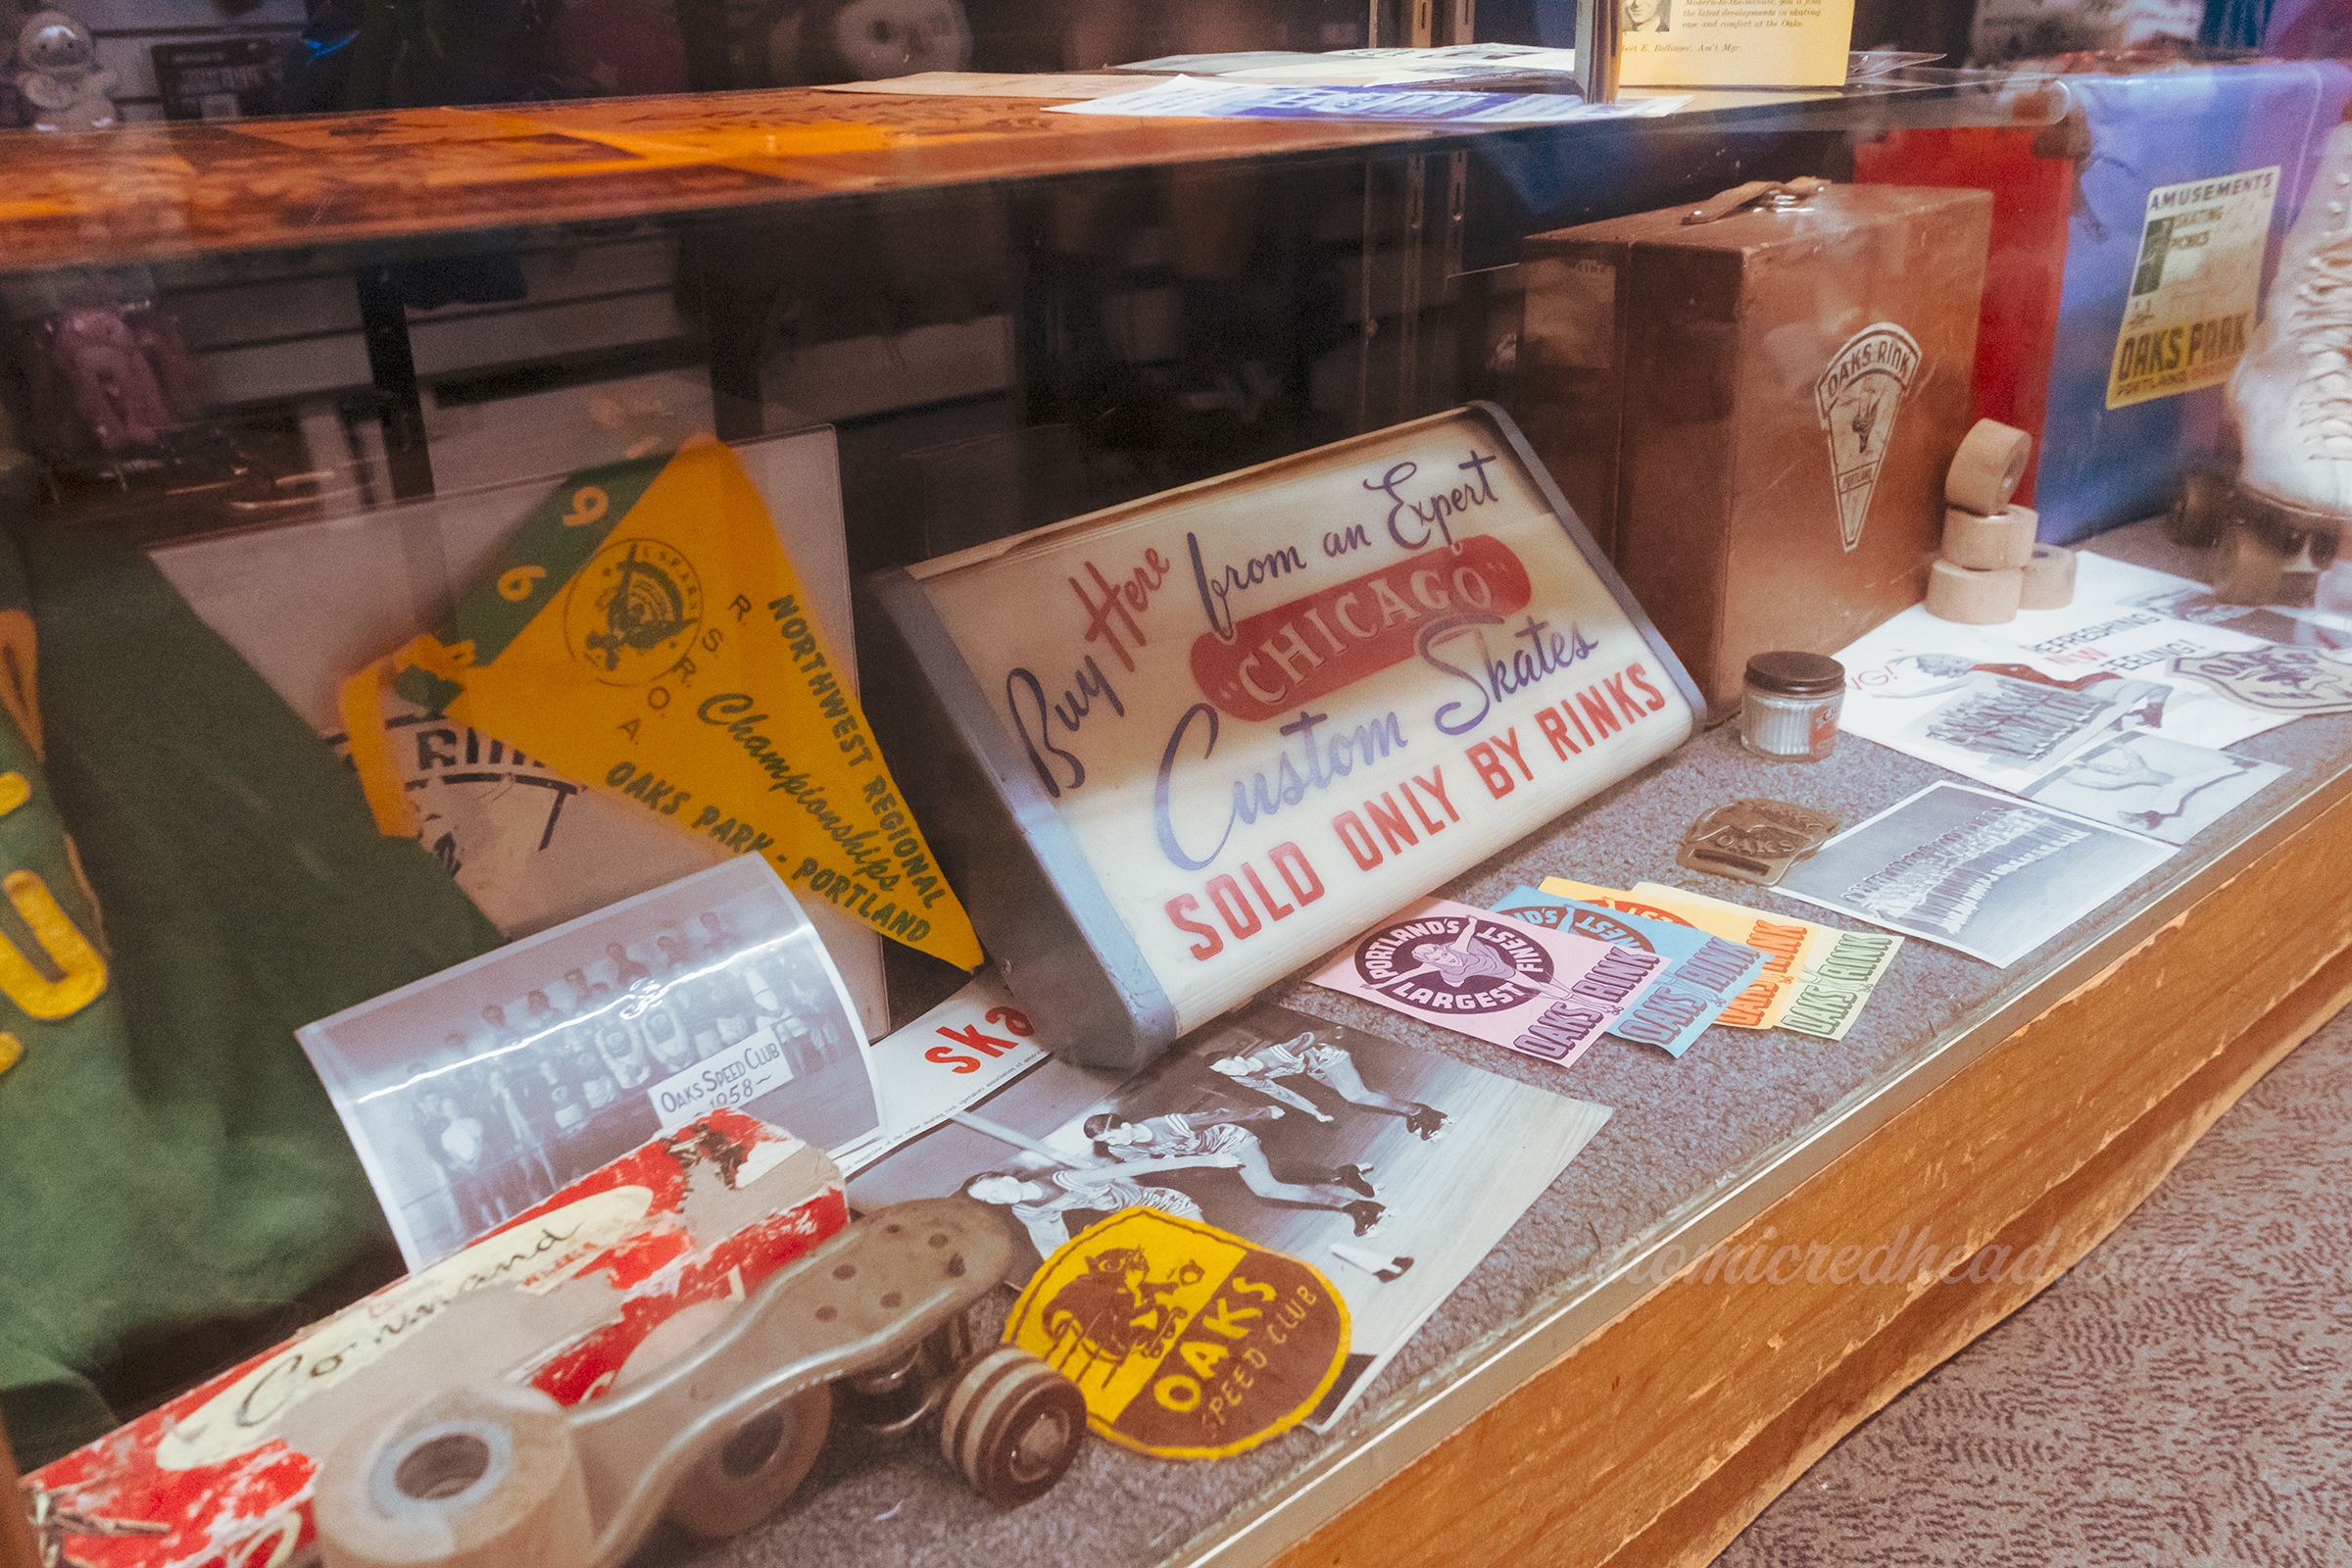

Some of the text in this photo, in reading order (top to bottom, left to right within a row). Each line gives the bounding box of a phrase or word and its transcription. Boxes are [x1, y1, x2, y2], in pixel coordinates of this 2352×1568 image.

[1720, 20, 1751, 29] comfort
[1722, 9, 1776, 19] developments
[1722, 44, 1742, 53] Mgr.
[2149, 172, 2275, 211] AMUSEMENTS
[1828, 340, 1911, 397] OAKS RINK
[2118, 325, 2183, 382] OAKS
[1006, 450, 1499, 799] Buy Here from an Expert
[767, 594, 946, 909] NORTHWEST REGIONAL
[1154, 613, 1598, 870] Custom Skates
[697, 692, 901, 893] Championships
[1163, 662, 1666, 961] SOLD ONLY BY RINKS
[606, 760, 691, 815] OAKS
[692, 806, 774, 854] PARK
[792, 858, 930, 943] PORTLAND
[1364, 918, 1460, 980] PORTLAND'S
[1476, 925, 1544, 973] FINEST
[1781, 933, 1893, 1036] OAKS RINK
[1392, 981, 1528, 1010] LARGEST
[1513, 946, 1661, 1060] OAKS RINK
[1618, 935, 1761, 1045] OAKS RINK
[661, 1042, 781, 1114] OAKS SPEED CLUB
[1153, 1276, 1277, 1412] OAKS
[1267, 1285, 1317, 1346] CLUB
